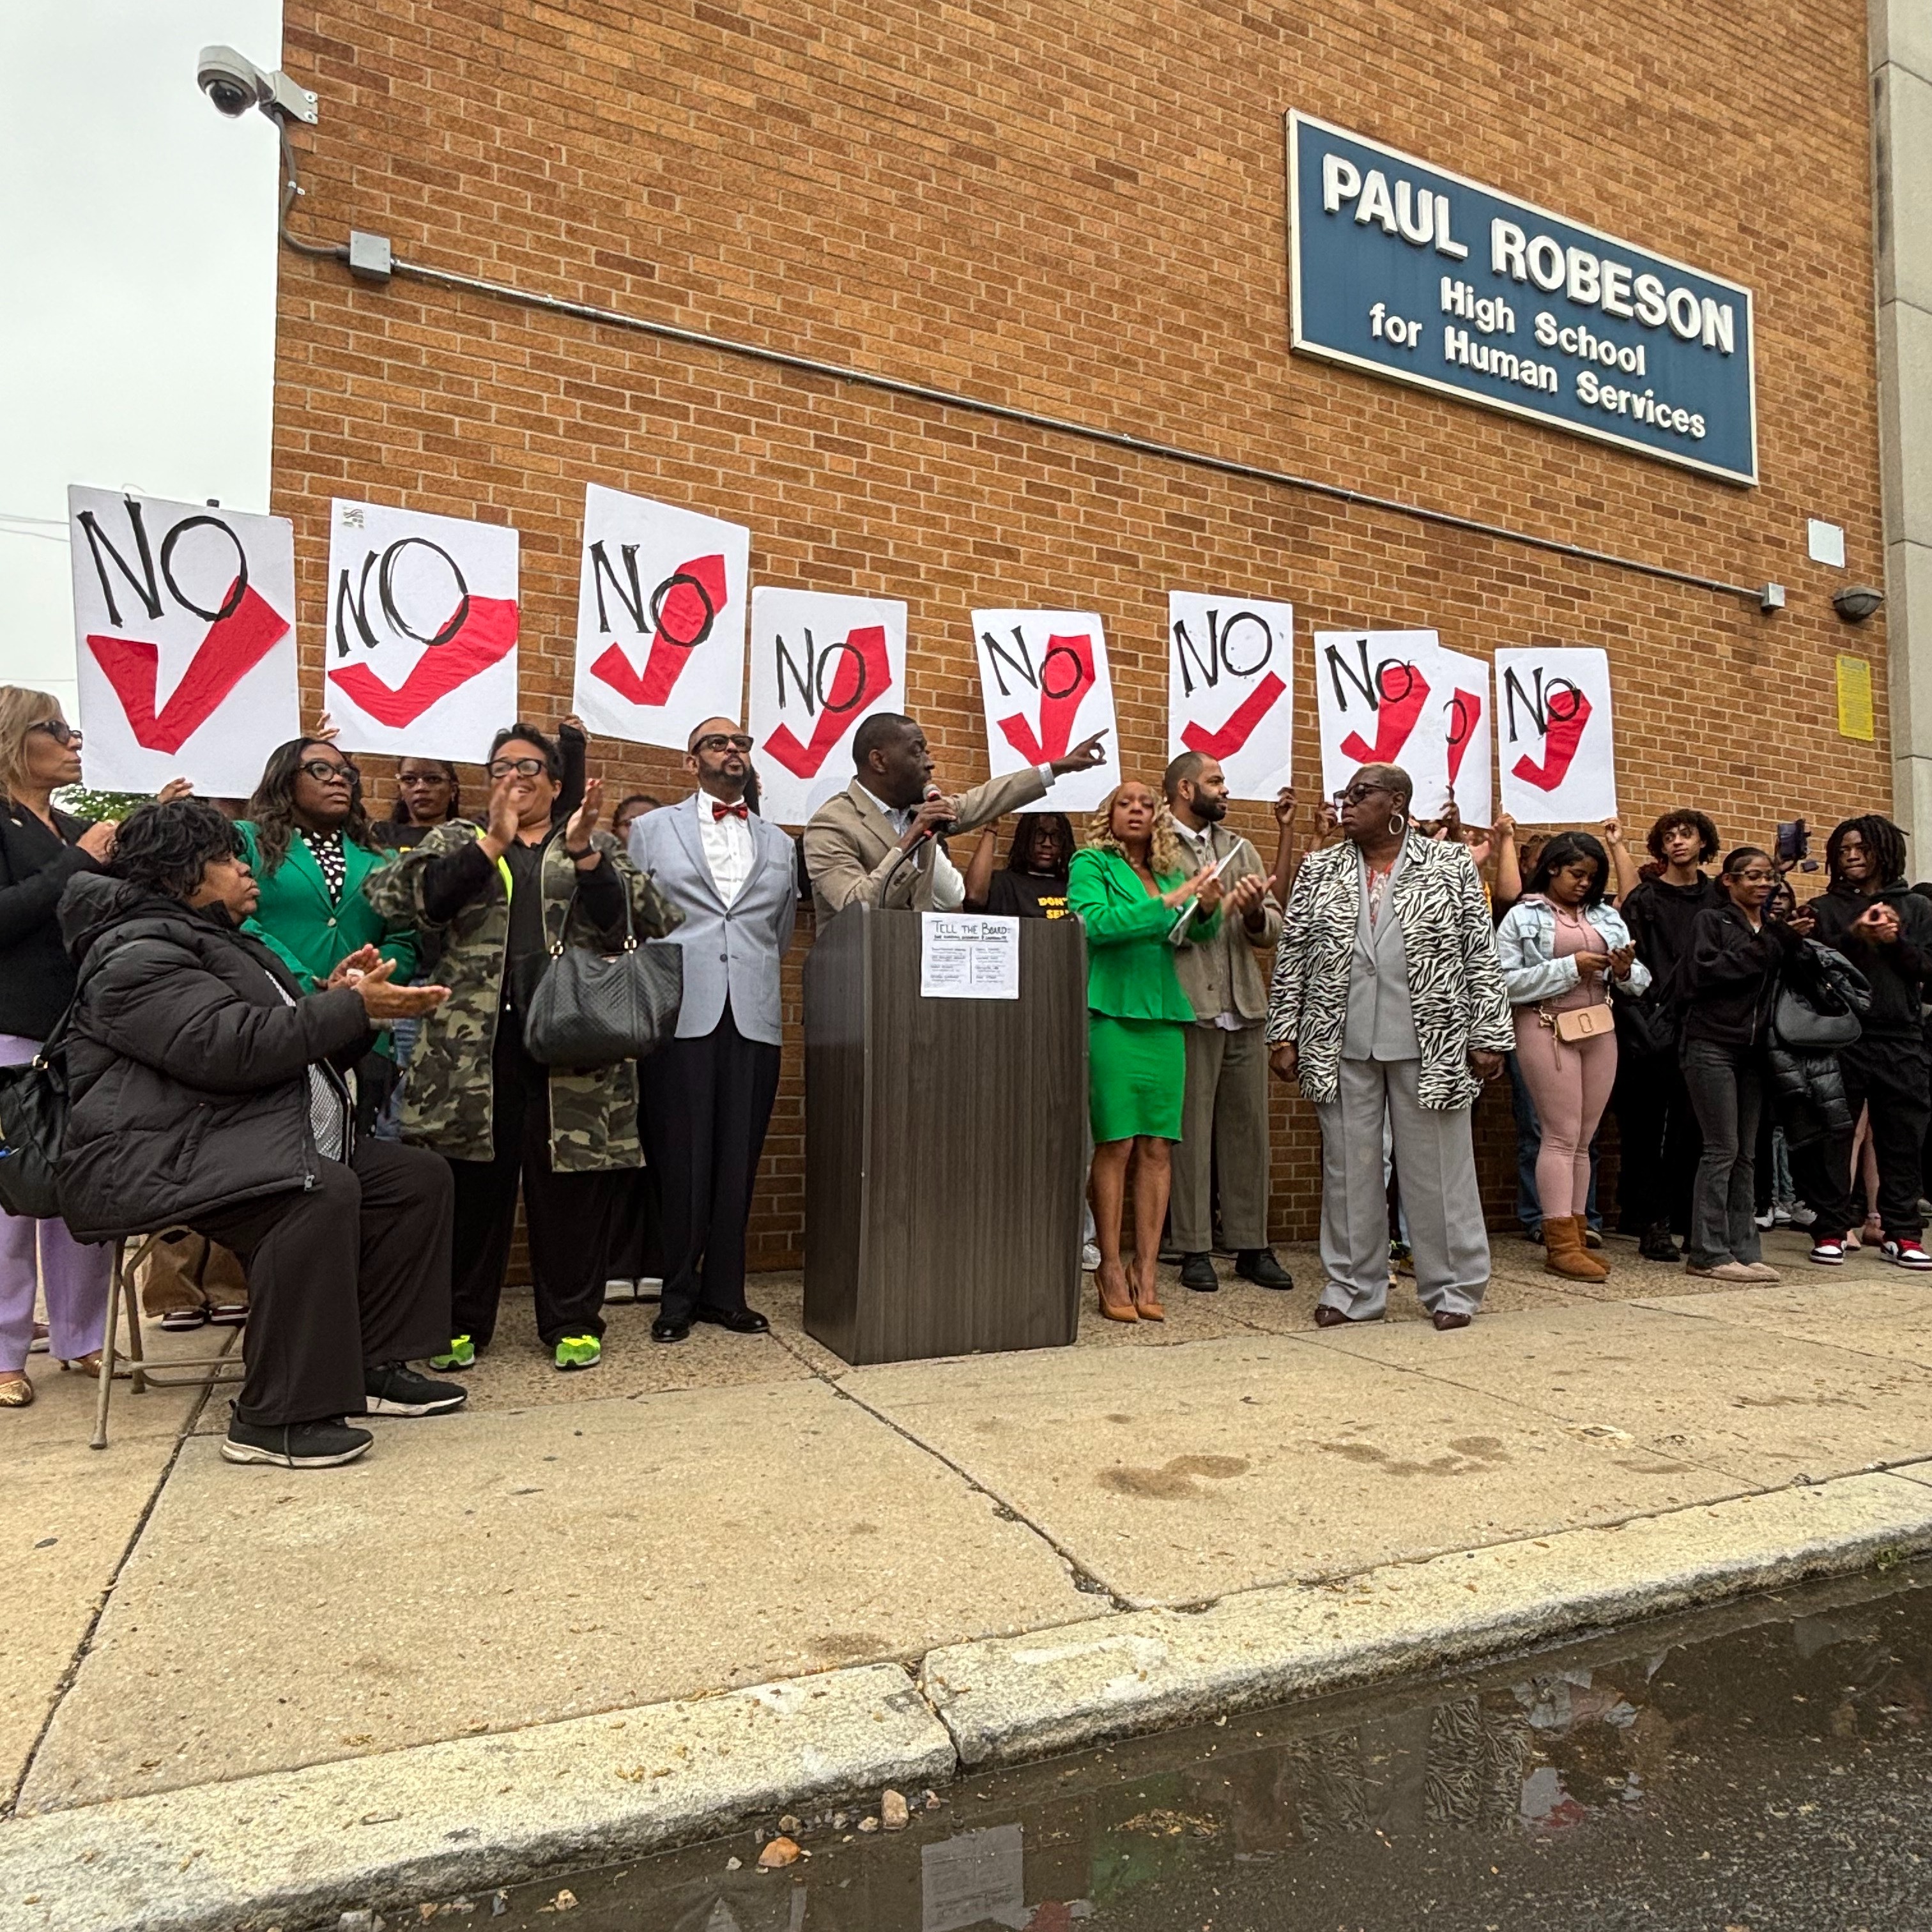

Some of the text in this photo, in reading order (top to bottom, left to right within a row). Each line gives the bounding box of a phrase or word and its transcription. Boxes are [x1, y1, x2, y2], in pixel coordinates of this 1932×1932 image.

[1323, 153, 1733, 356] PAUL ROBESON
[1370, 303, 1705, 440] for Human Services
[1441, 276, 1645, 377] High School
[77, 495, 248, 628] NO
[335, 537, 469, 658] NO
[776, 627, 866, 716] NO
[1174, 610, 1273, 697] NO
[931, 920, 958, 933] TELL
[961, 924, 978, 934] THE
